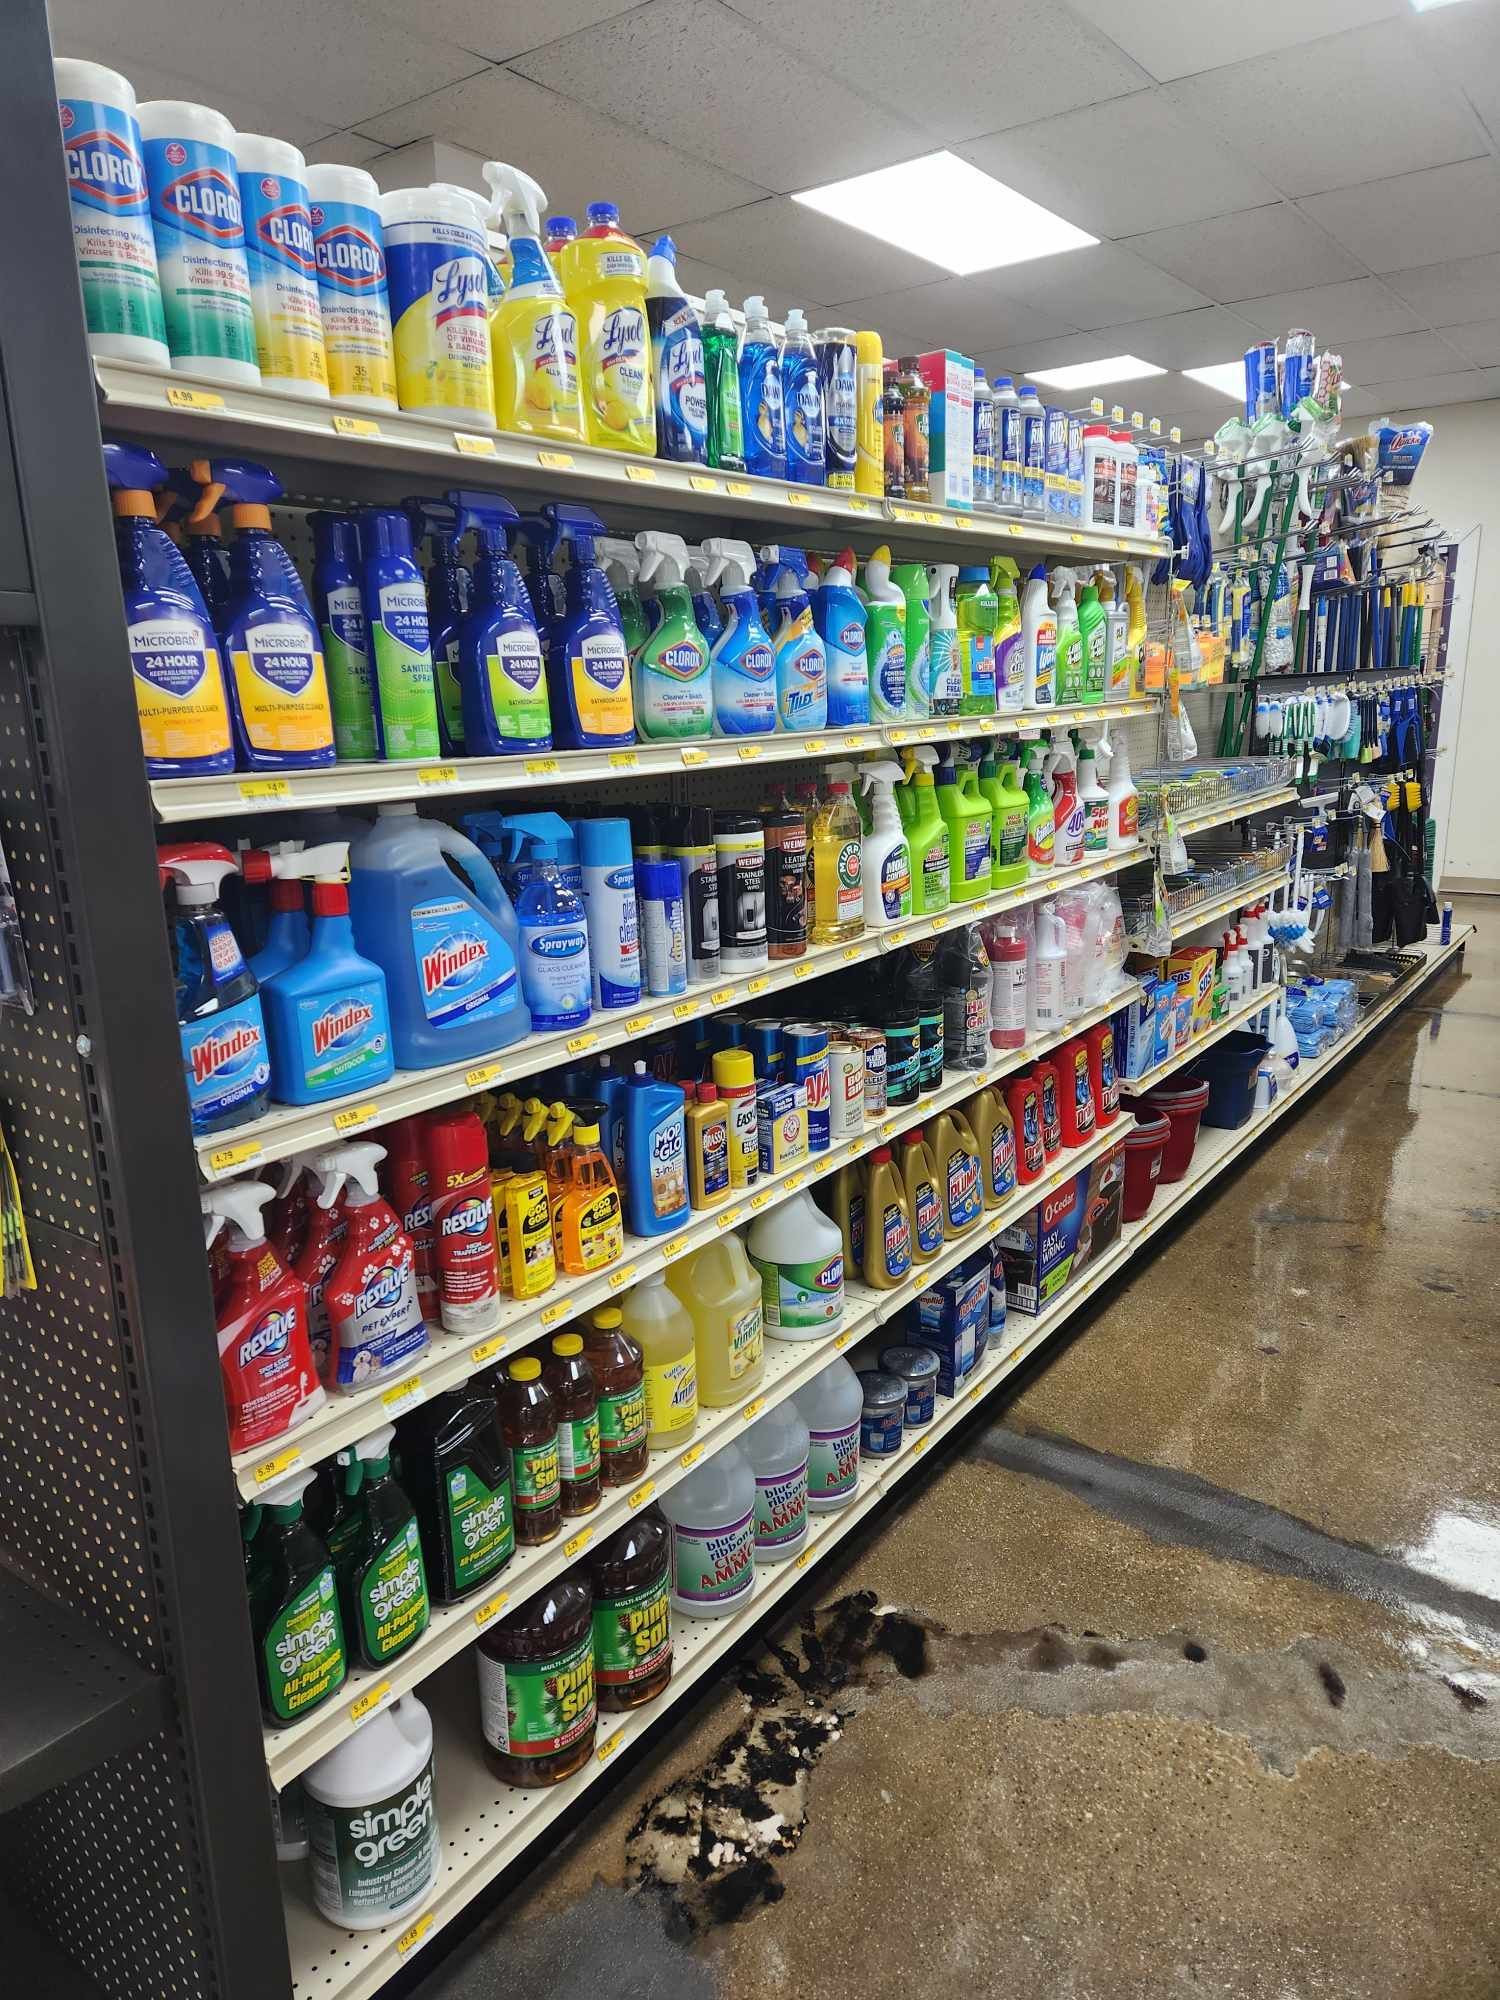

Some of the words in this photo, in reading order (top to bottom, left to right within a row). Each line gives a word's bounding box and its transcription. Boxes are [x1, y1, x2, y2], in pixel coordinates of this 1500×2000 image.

[66, 149, 145, 193] CLOROX
[315, 242, 381, 276] CLOROX
[435, 261, 485, 305] Lysol
[602, 312, 643, 354] Lysol
[354, 365, 368, 377] 35
[619, 366, 643, 380] CLEAN
[387, 596, 426, 608] MICROB
[395, 615, 411, 627] 24
[411, 616, 429, 627] HOU
[145, 655, 164, 669] 24
[165, 655, 199, 667] HOUR
[264, 656, 281, 669] 24
[281, 656, 310, 668] HOUR
[509, 659, 522, 669] 24
[522, 659, 539, 669] HOUR
[592, 660, 605, 669] 24
[605, 660, 623, 670] HOUR
[665, 650, 701, 668] CLOROX
[745, 651, 773, 669] CLOROX
[539, 936, 584, 952] Sprayway
[423, 940, 487, 994] Windex
[1171, 970, 1192, 983] SOS
[465, 993, 491, 1011] ORIGINAL
[312, 1005, 372, 1055] Windex
[192, 1027, 261, 1083] Windex
[334, 1054, 366, 1076] OUTDOOR
[220, 1085, 255, 1106] ORIGINAL
[804, 1069, 830, 1107] AJA
[655, 1121, 681, 1148] MOP
[659, 1140, 683, 1162] GLO
[447, 1172, 464, 1188] 5X
[655, 1162, 675, 1179] 3-in-1
[528, 1201, 547, 1218] GOO
[592, 1196, 611, 1212] GOO
[593, 1206, 612, 1220] GONE
[529, 1212, 549, 1226] GONE
[1042, 1229, 1059, 1252] EASY
[1042, 1238, 1066, 1264] WRING
[356, 1262, 409, 1319] RESOLVE
[239, 1307, 297, 1367] RESOLVE
[362, 1321, 378, 1334] PET
[832, 1432, 855, 1452] blue
[257, 1462, 275, 1477] 5.99
[764, 1480, 793, 1499] blue
[461, 1494, 505, 1534] simple
[464, 1511, 506, 1549] green
[705, 1531, 737, 1551] blue
[459, 1544, 492, 1568] All-Purpose
[710, 1531, 751, 1562] ribbon
[369, 1557, 419, 1603] simple
[373, 1574, 421, 1620] green
[377, 1594, 426, 1640] All-Purpose
[275, 1610, 334, 1652] simple
[381, 1619, 416, 1653] Cleaner
[634, 1615, 669, 1656] Sol
[279, 1627, 337, 1674] green
[283, 1649, 341, 1697] All-Purpose
[288, 1675, 330, 1710] Cleaner
[561, 1676, 594, 1723] Sol
[349, 1773, 432, 1841] simple
[354, 1799, 432, 1868] green
[357, 1871, 392, 1887] Industrial
